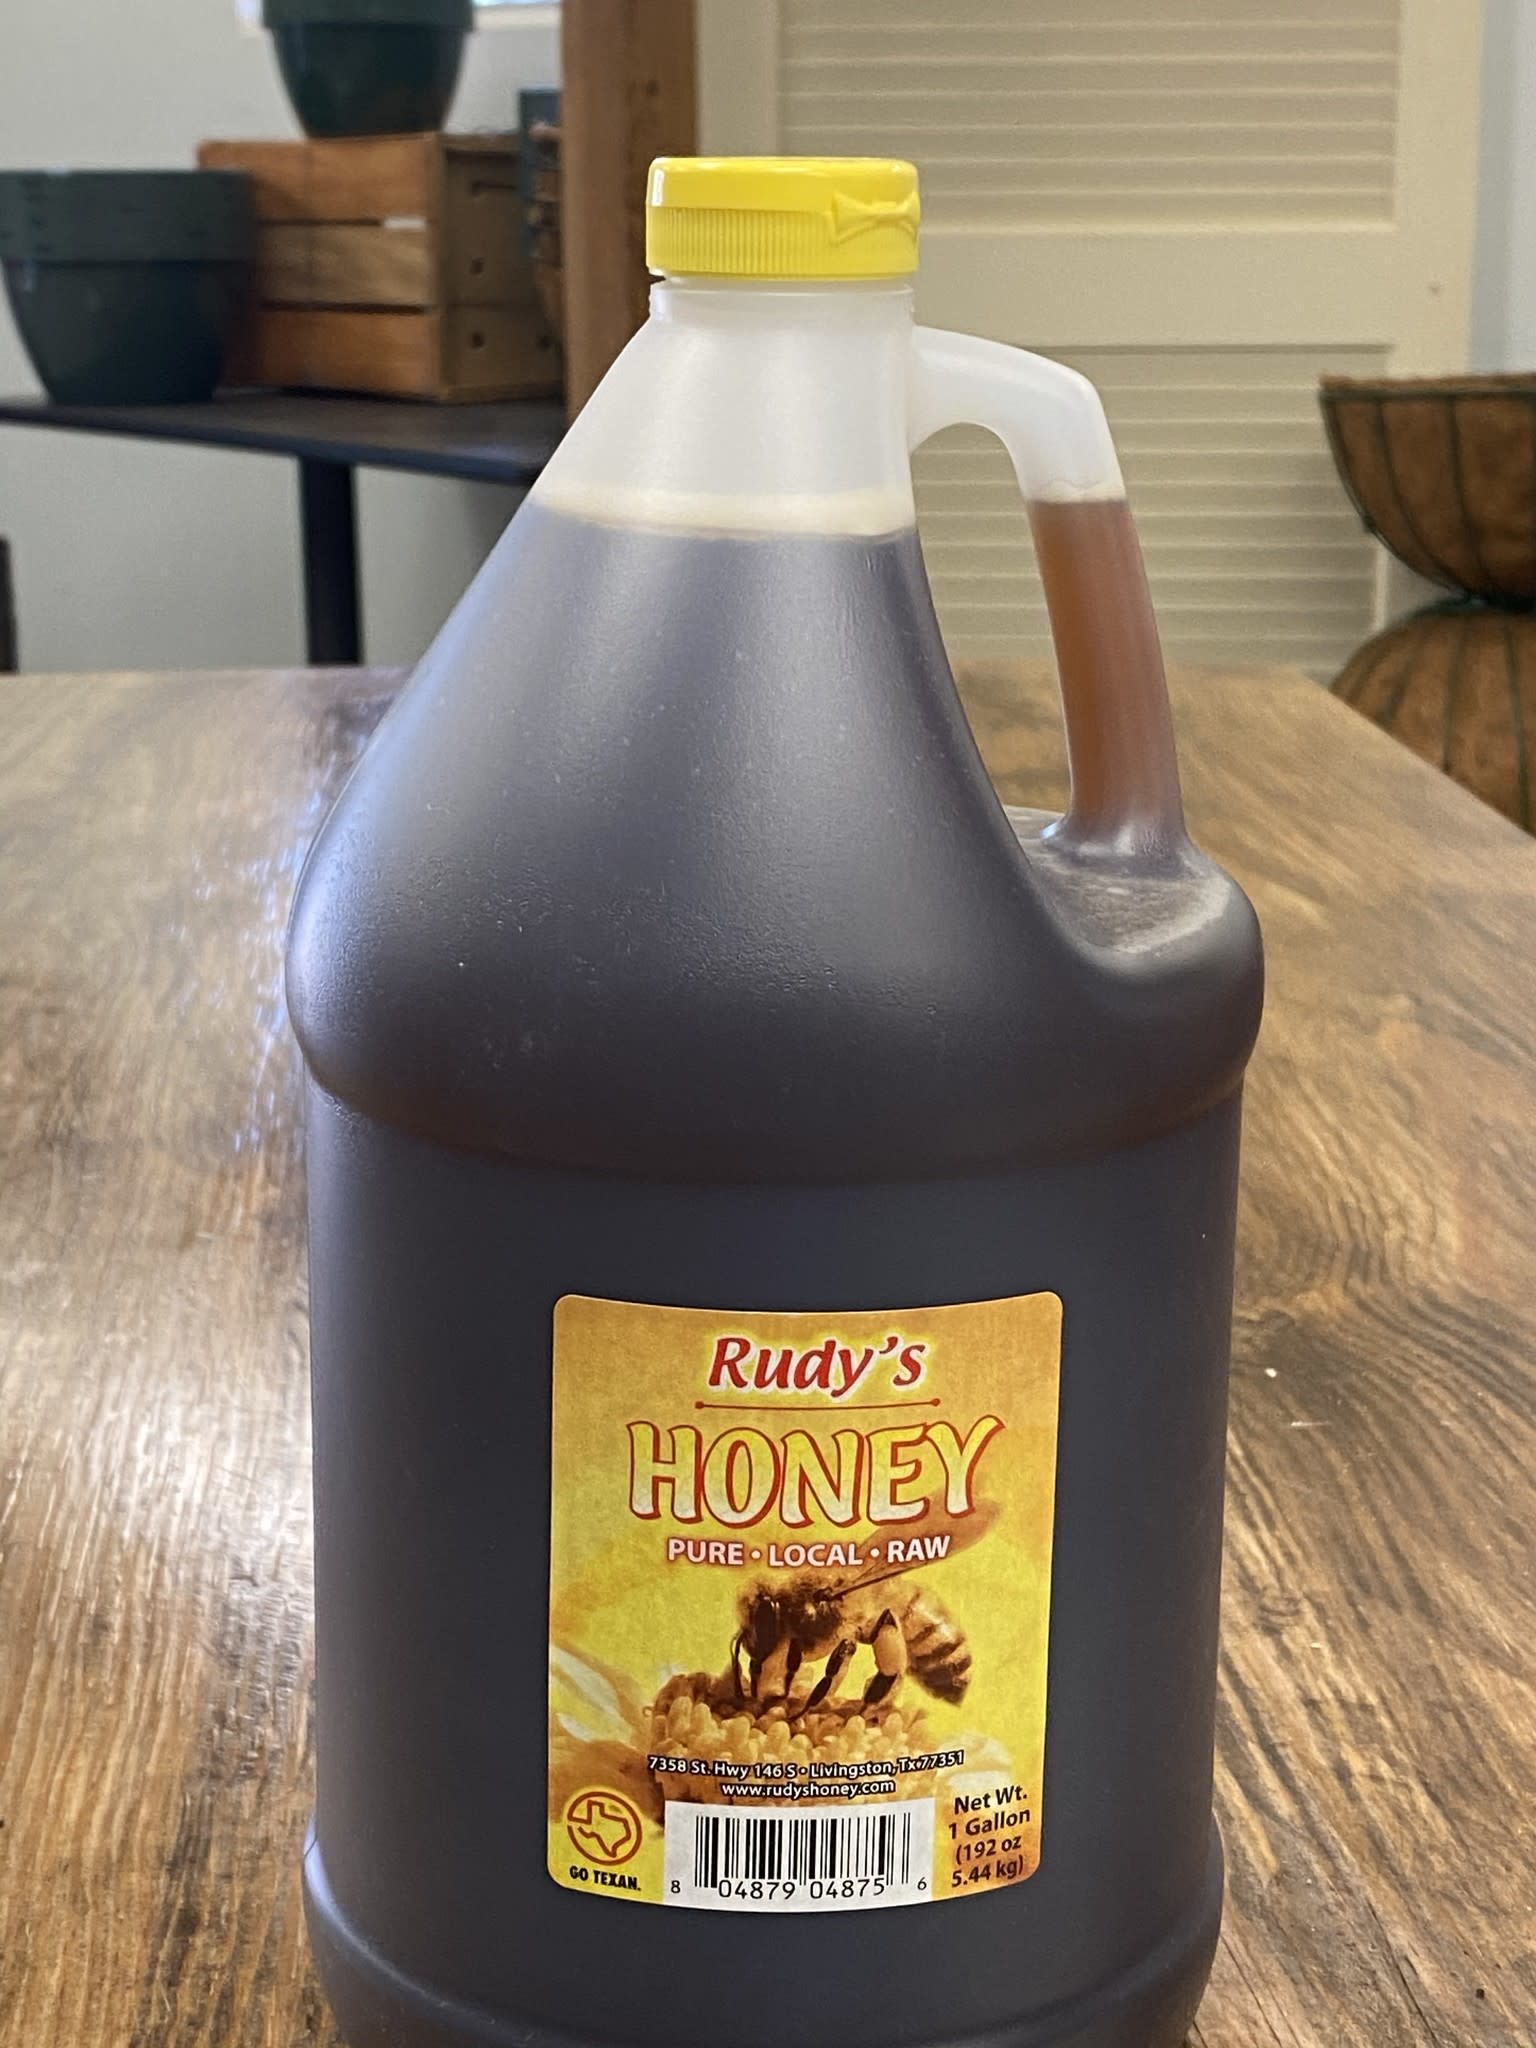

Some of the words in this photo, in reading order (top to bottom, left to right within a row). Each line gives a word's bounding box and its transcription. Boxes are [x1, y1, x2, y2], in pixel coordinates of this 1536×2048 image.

[626, 1415, 1006, 1528] HONEY
[667, 1537, 745, 1566] PURE
[769, 1543, 863, 1568] LOCAL
[887, 1535, 951, 1562] RAW
[649, 1756, 687, 1772] 7358
[691, 1761, 711, 1775] St.
[714, 1761, 749, 1778] Hwy
[754, 1763, 782, 1778] 146
[786, 1763, 796, 1778] S
[810, 1761, 898, 1779] Livingston,
[722, 1779, 895, 1799] www.rudyshoney.com
[953, 1793, 991, 1815] Net
[994, 1784, 1029, 1806] Wt.
[948, 1822, 957, 1840] 1
[965, 1808, 1031, 1836] Gallon
[955, 1840, 997, 1866] (192
[1001, 1834, 1023, 1851] oz
[569, 1865, 590, 1882] GO
[950, 1866, 992, 1888] 5.44
[995, 1853, 1025, 1878] kg)
[670, 1880, 681, 1894] 8
[718, 1879, 796, 1900] 04879
[809, 1877, 886, 1899] 04875
[916, 1877, 928, 1891] 6
